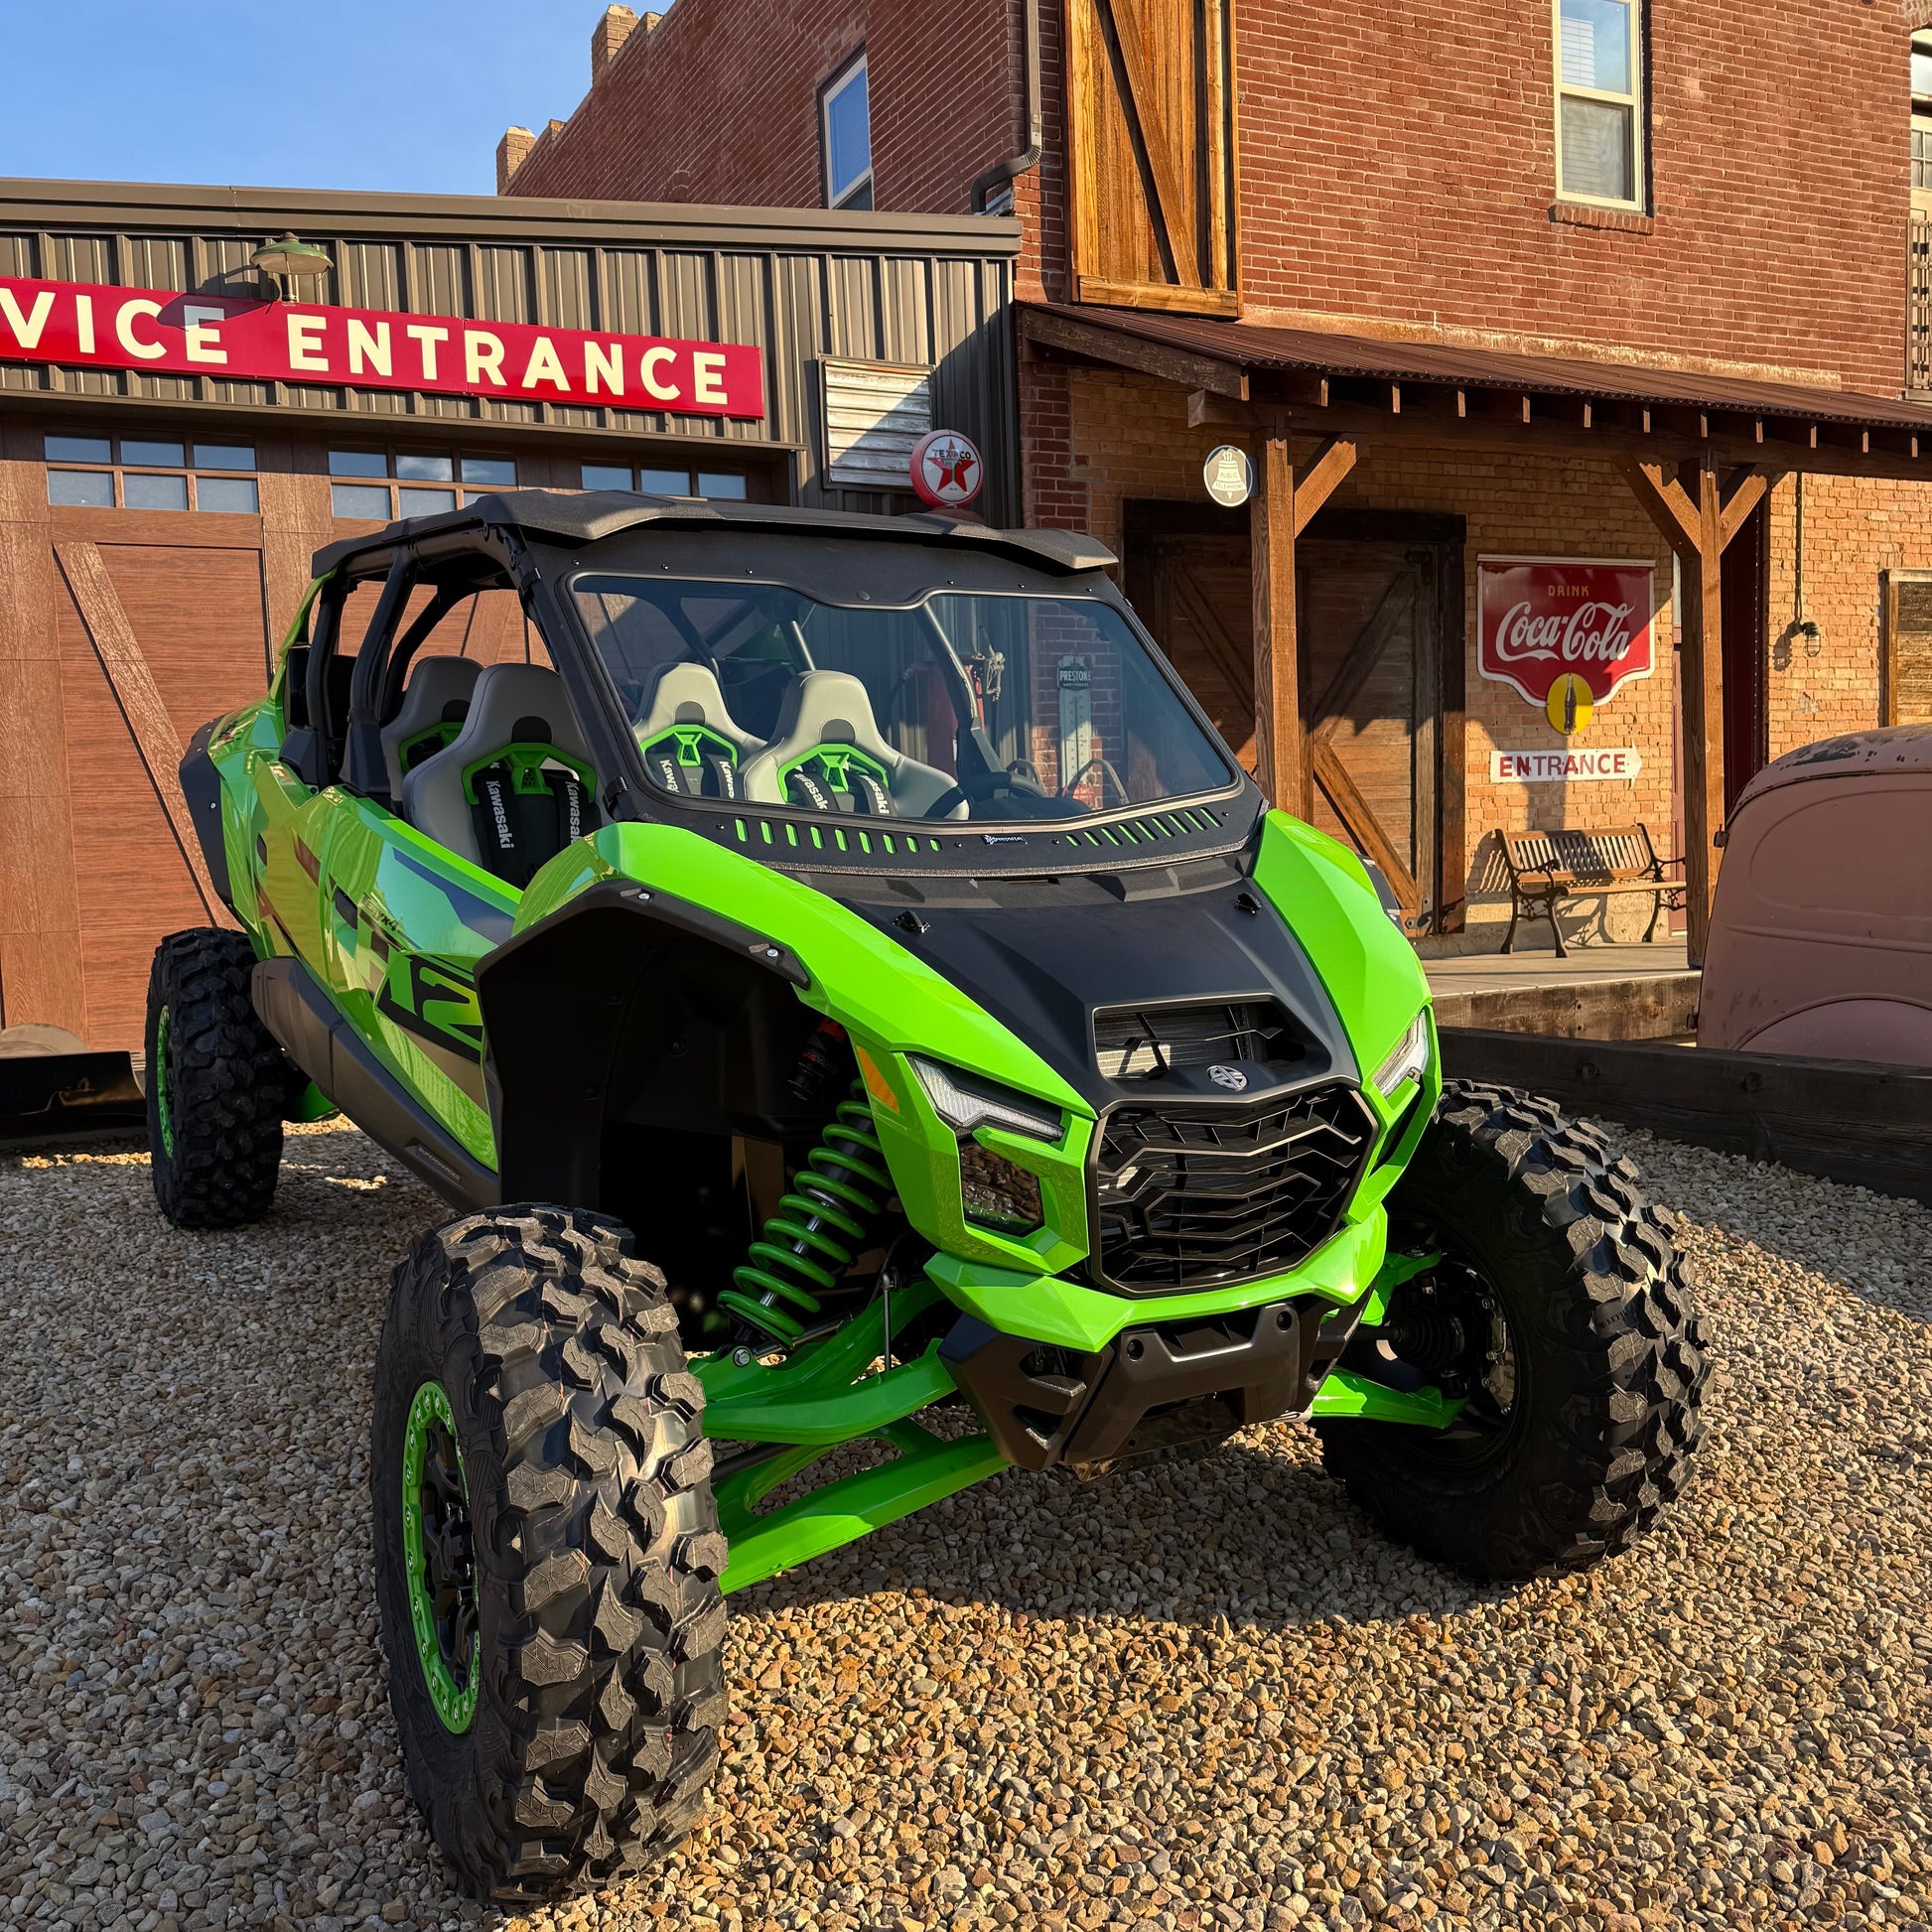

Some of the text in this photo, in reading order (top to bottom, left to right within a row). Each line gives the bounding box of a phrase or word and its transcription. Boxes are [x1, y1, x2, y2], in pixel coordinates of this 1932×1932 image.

[288, 315, 728, 405] ENTRANCE
[932, 449, 972, 460] TEXACO
[1548, 585, 1589, 597] DRINK
[1496, 601, 1635, 662] Coca-Cola
[1059, 670, 1091, 682] PRESTONE
[1499, 754, 1626, 777] ENTRANCE
[485, 780, 514, 849] Kawasaki
[566, 780, 583, 845] Kawasak
